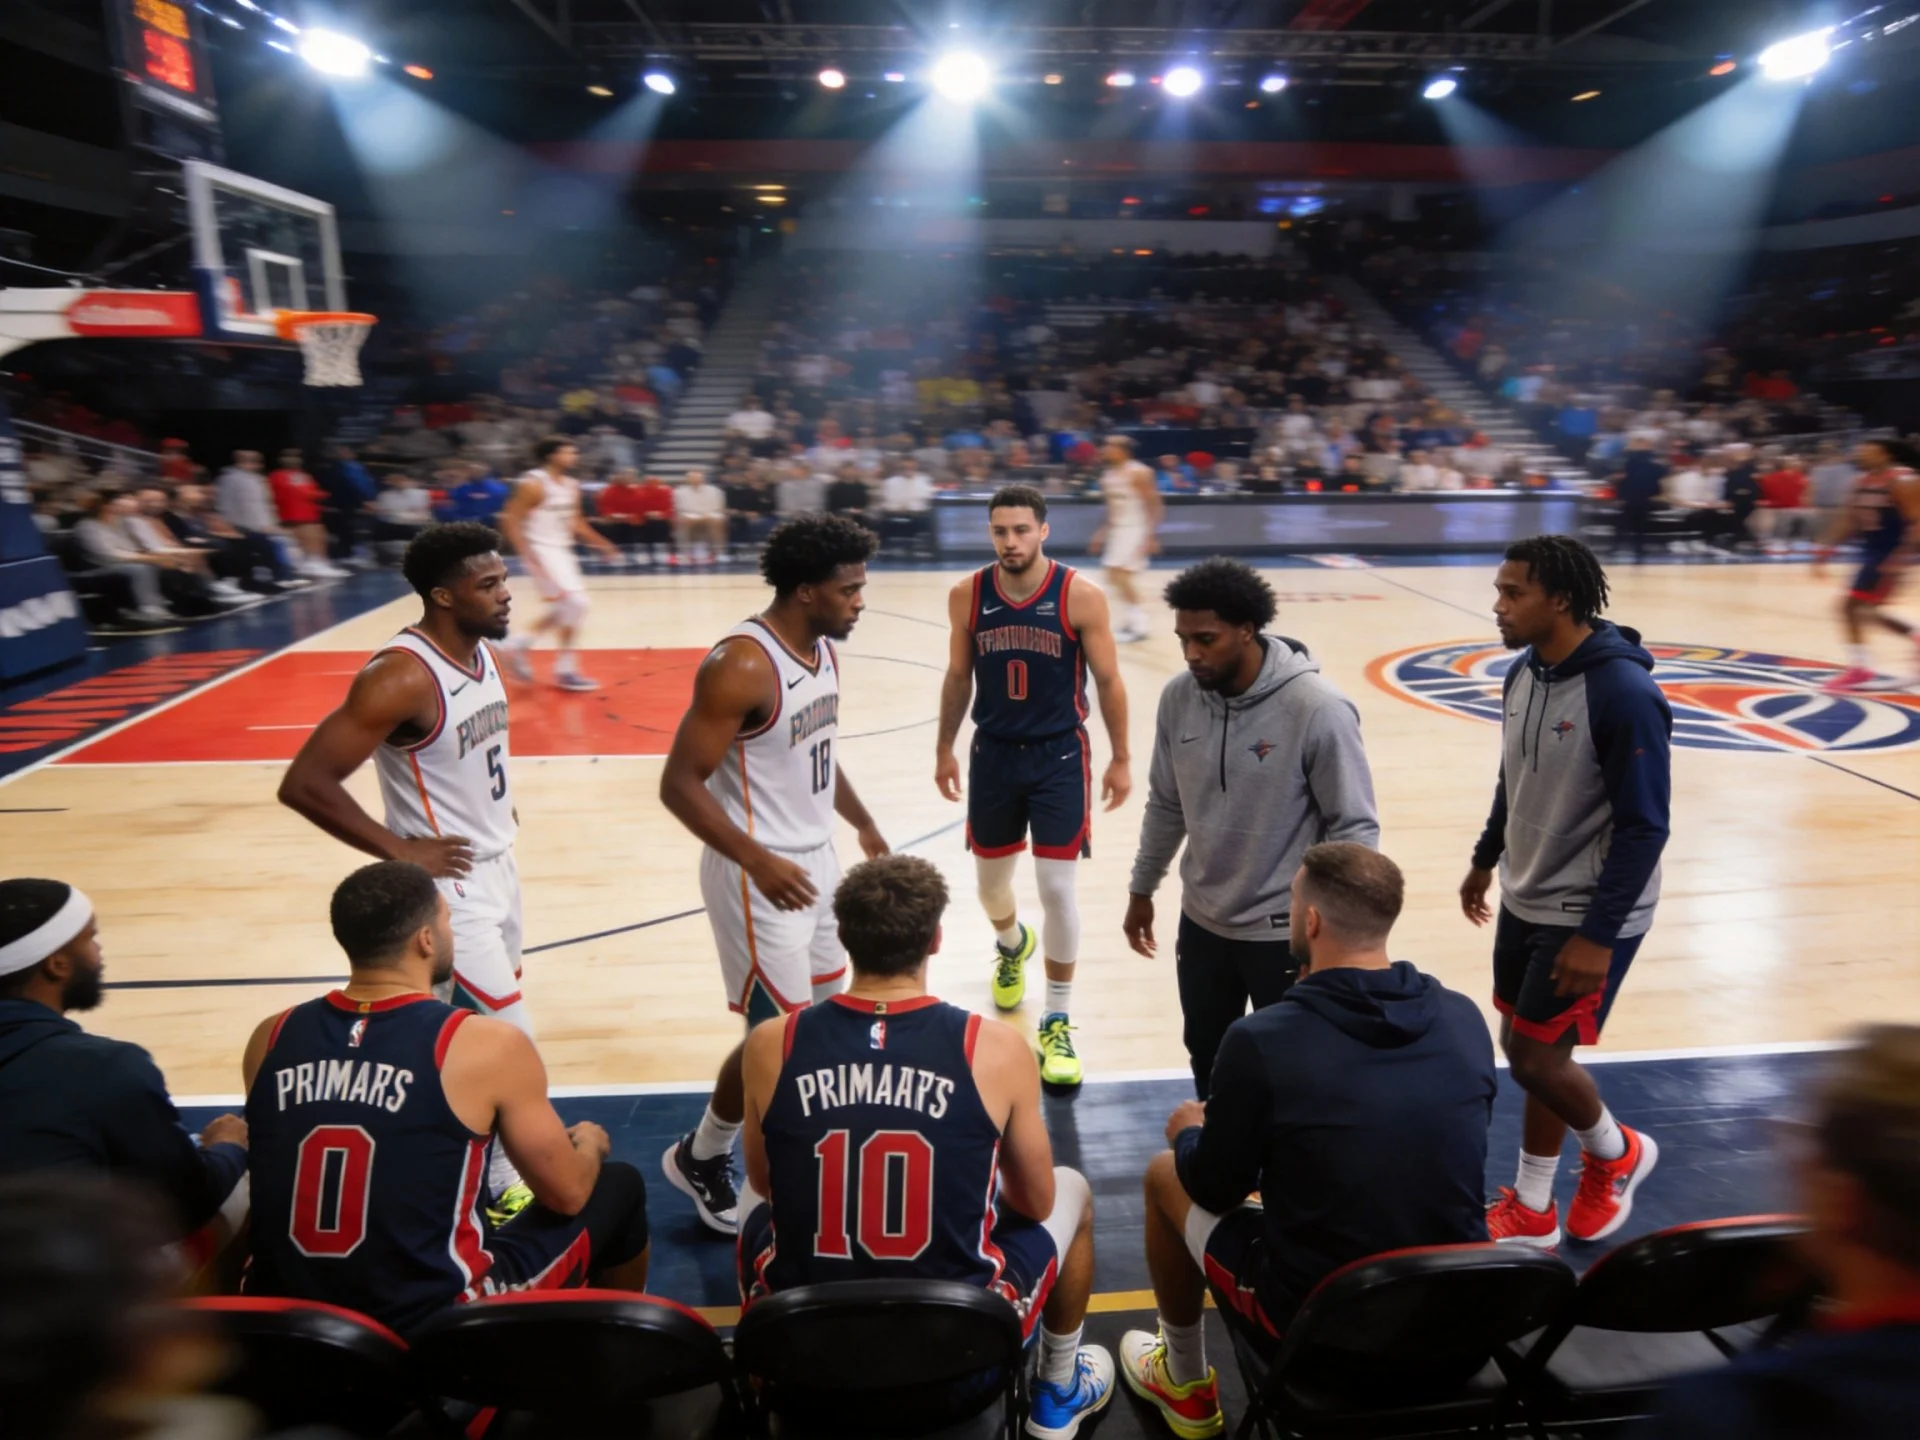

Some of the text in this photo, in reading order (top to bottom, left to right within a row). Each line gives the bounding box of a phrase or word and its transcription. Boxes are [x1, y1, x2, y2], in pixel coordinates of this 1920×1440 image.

[1007, 660, 1028, 700] 0
[487, 744, 506, 801] 5
[275, 1059, 413, 1113] PRIMARS
[289, 1125, 376, 1258] 0
[813, 1128, 934, 1262] 10
